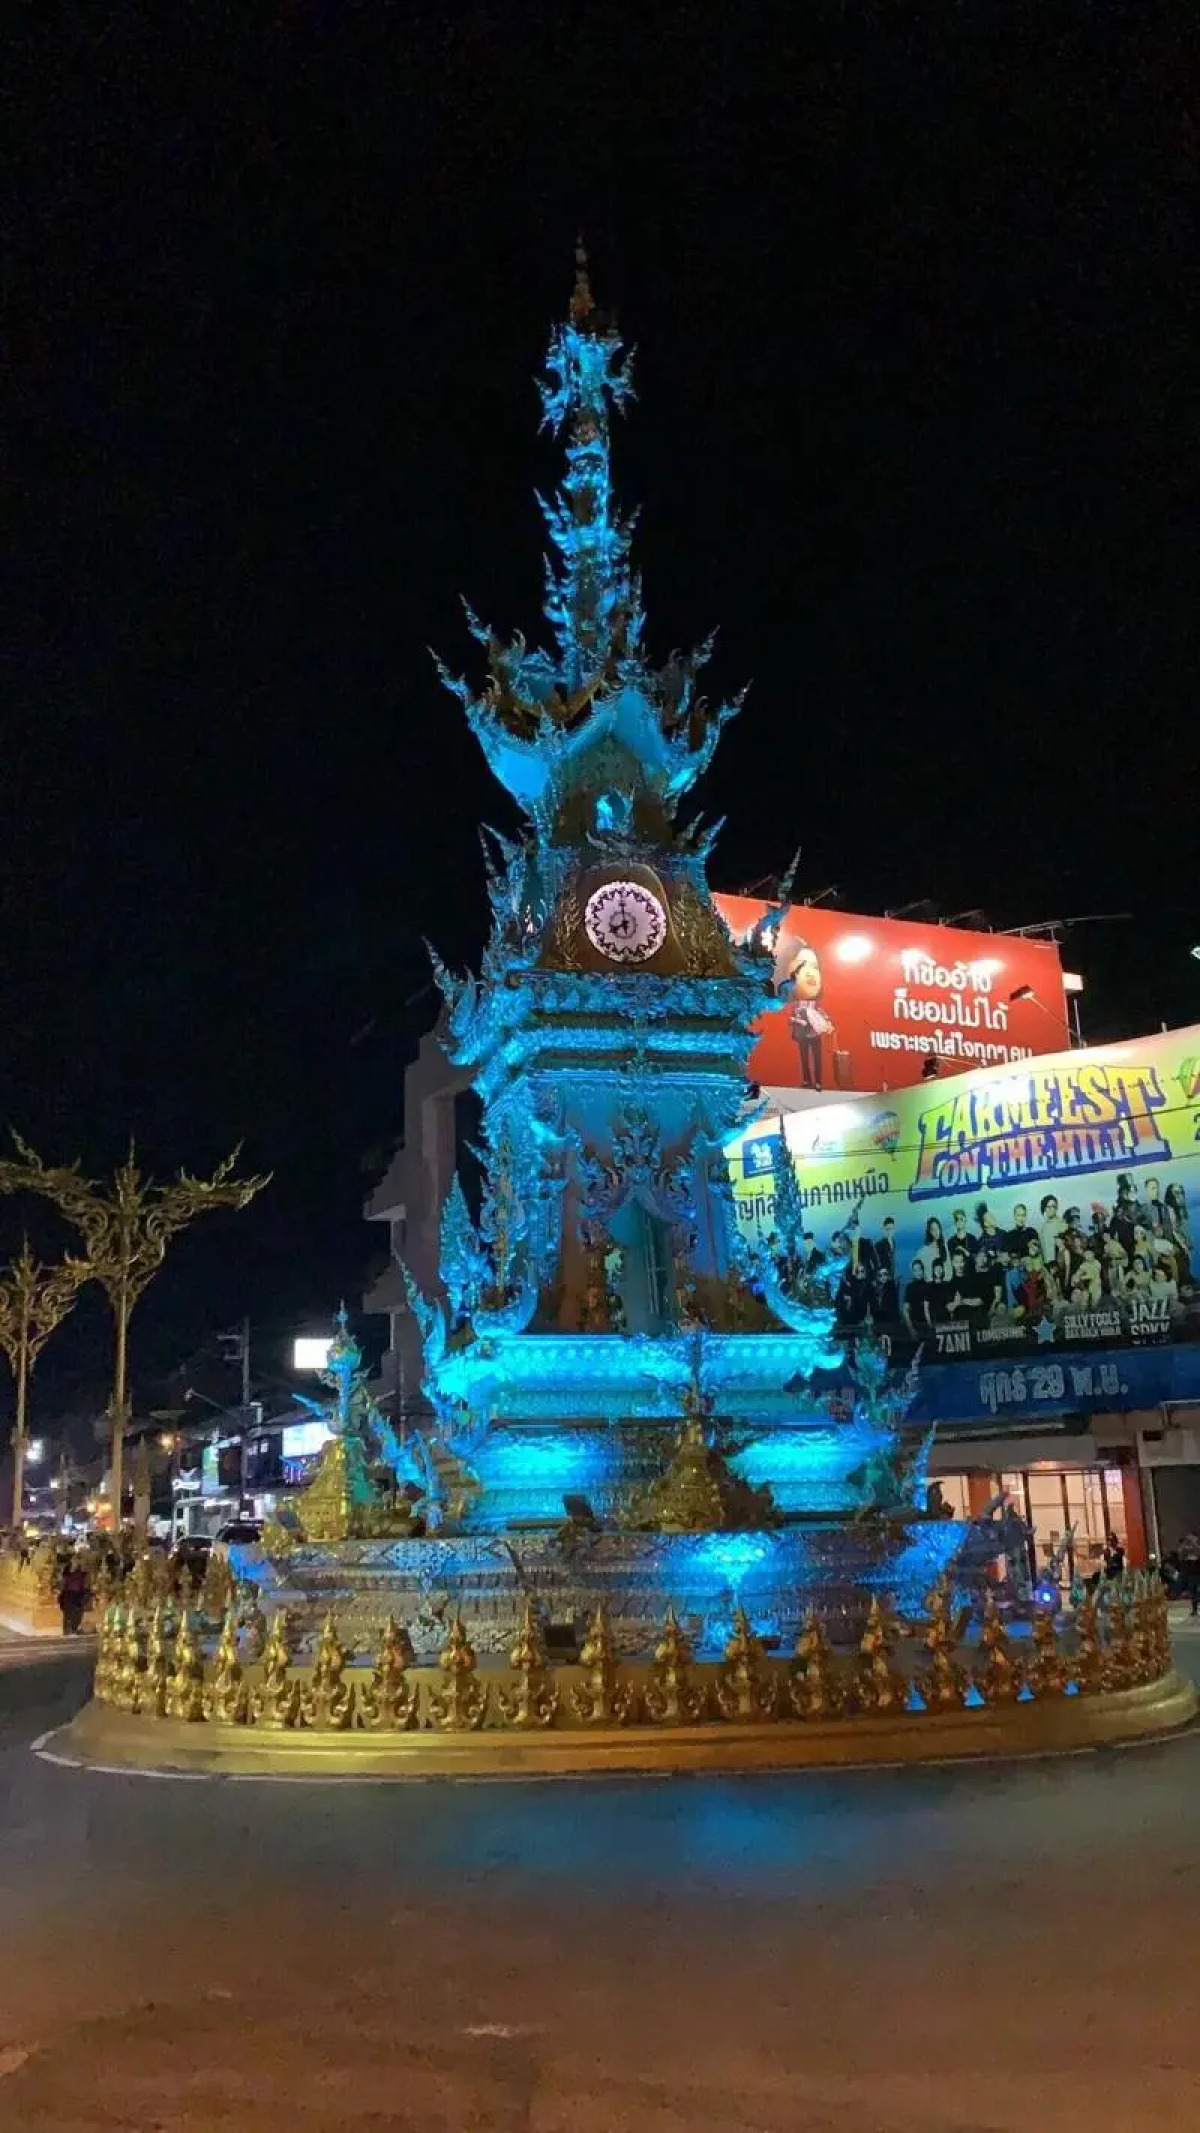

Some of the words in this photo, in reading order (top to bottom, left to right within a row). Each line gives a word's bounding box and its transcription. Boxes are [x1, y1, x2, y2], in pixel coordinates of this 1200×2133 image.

[893, 987, 1009, 1031] ก็ยอมไม่ได้
[938, 1150, 980, 1188] ON
[986, 1131, 1049, 1181] THE
[1052, 1126, 1133, 1170] HILL
